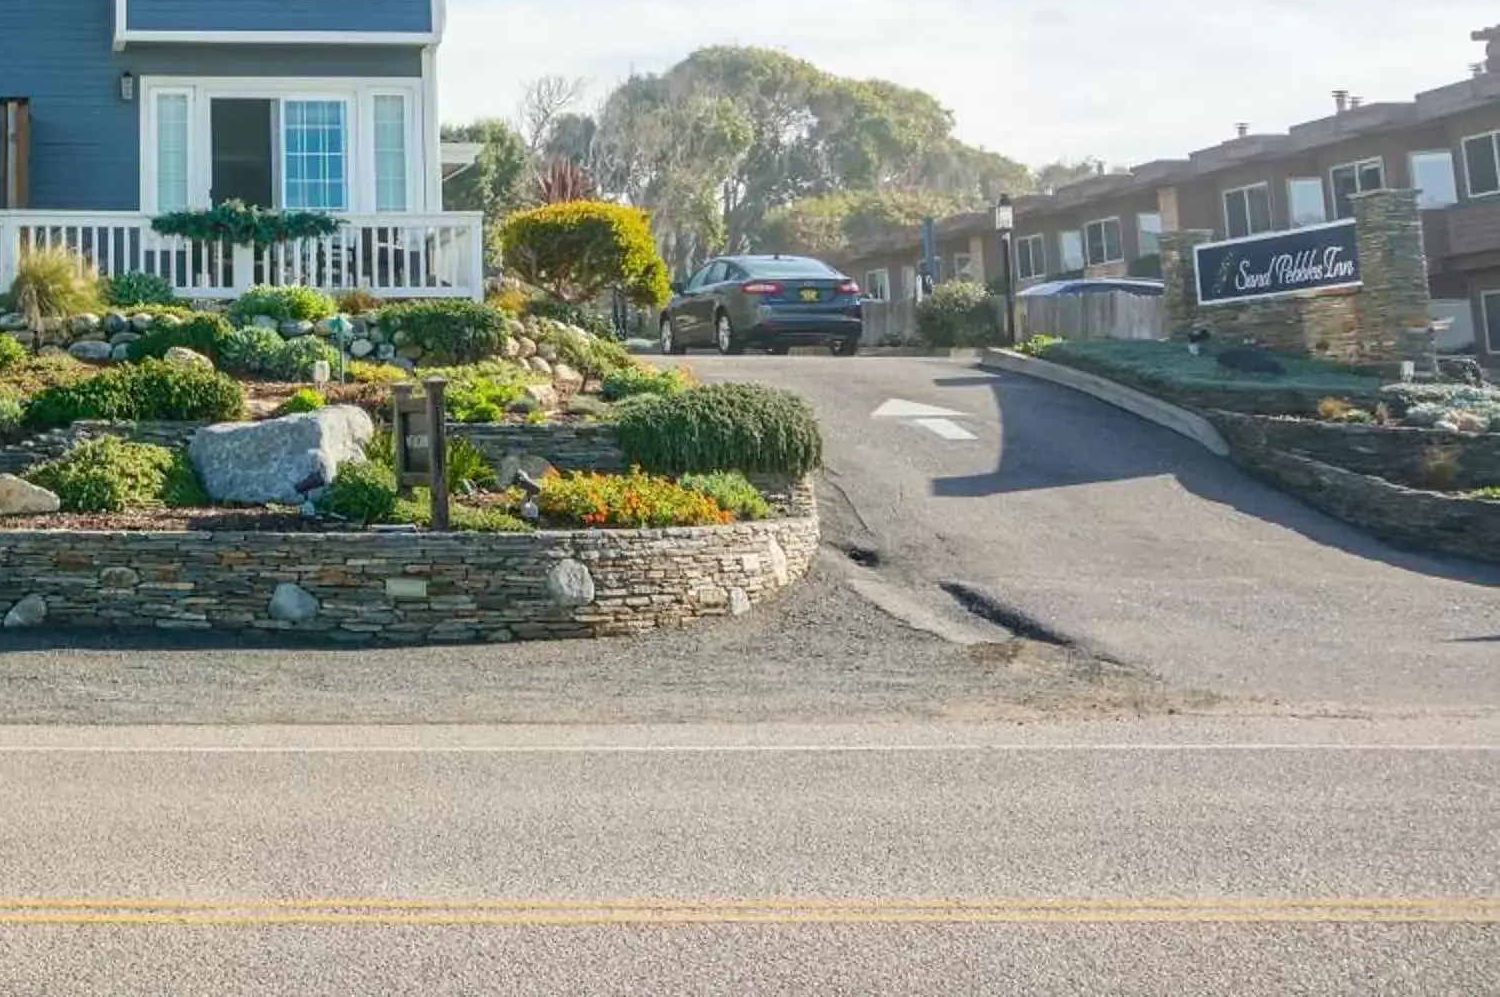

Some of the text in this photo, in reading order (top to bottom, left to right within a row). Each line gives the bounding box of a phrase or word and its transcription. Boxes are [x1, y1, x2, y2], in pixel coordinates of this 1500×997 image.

[1236, 246, 1355, 290] Sand Pebbles Inn
